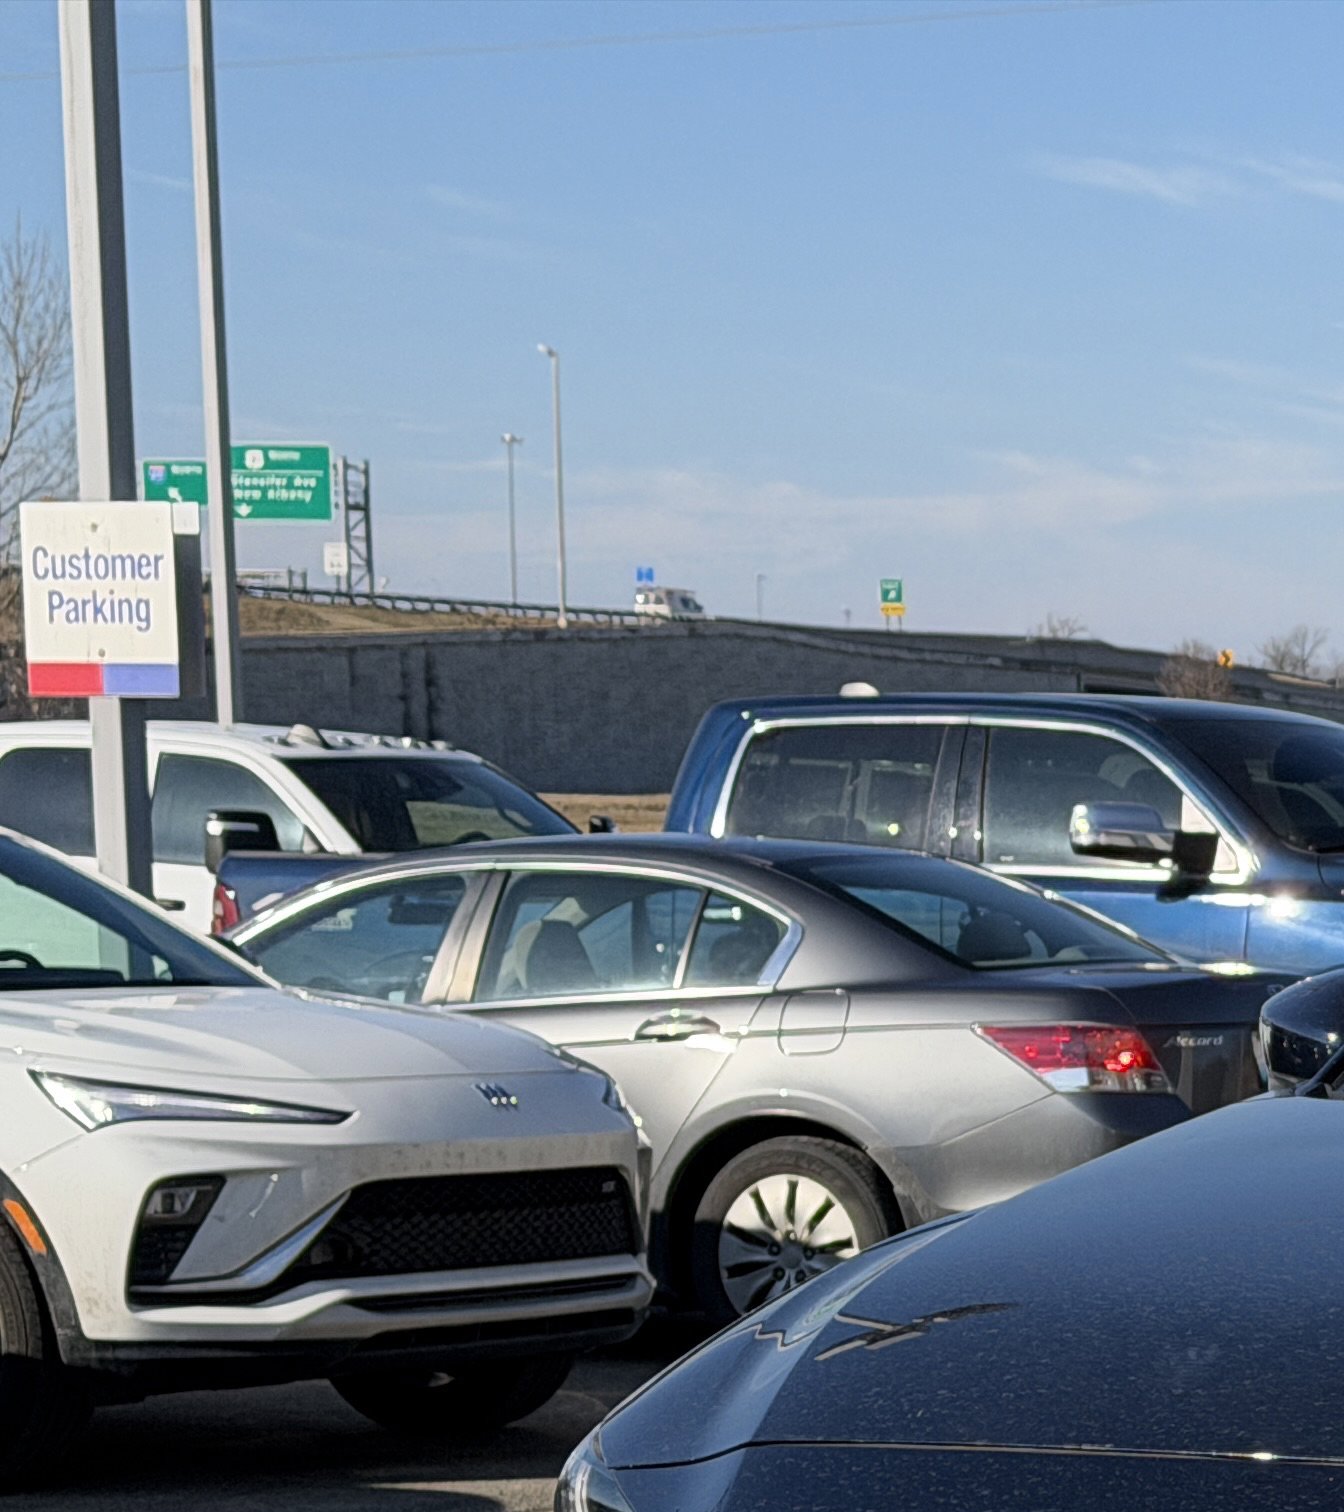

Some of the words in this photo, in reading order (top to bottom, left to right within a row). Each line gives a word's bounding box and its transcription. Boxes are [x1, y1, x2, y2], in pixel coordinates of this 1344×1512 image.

[32, 545, 165, 581] Customer
[47, 589, 151, 633] Parking
[1162, 1034, 1224, 1047] Accord
